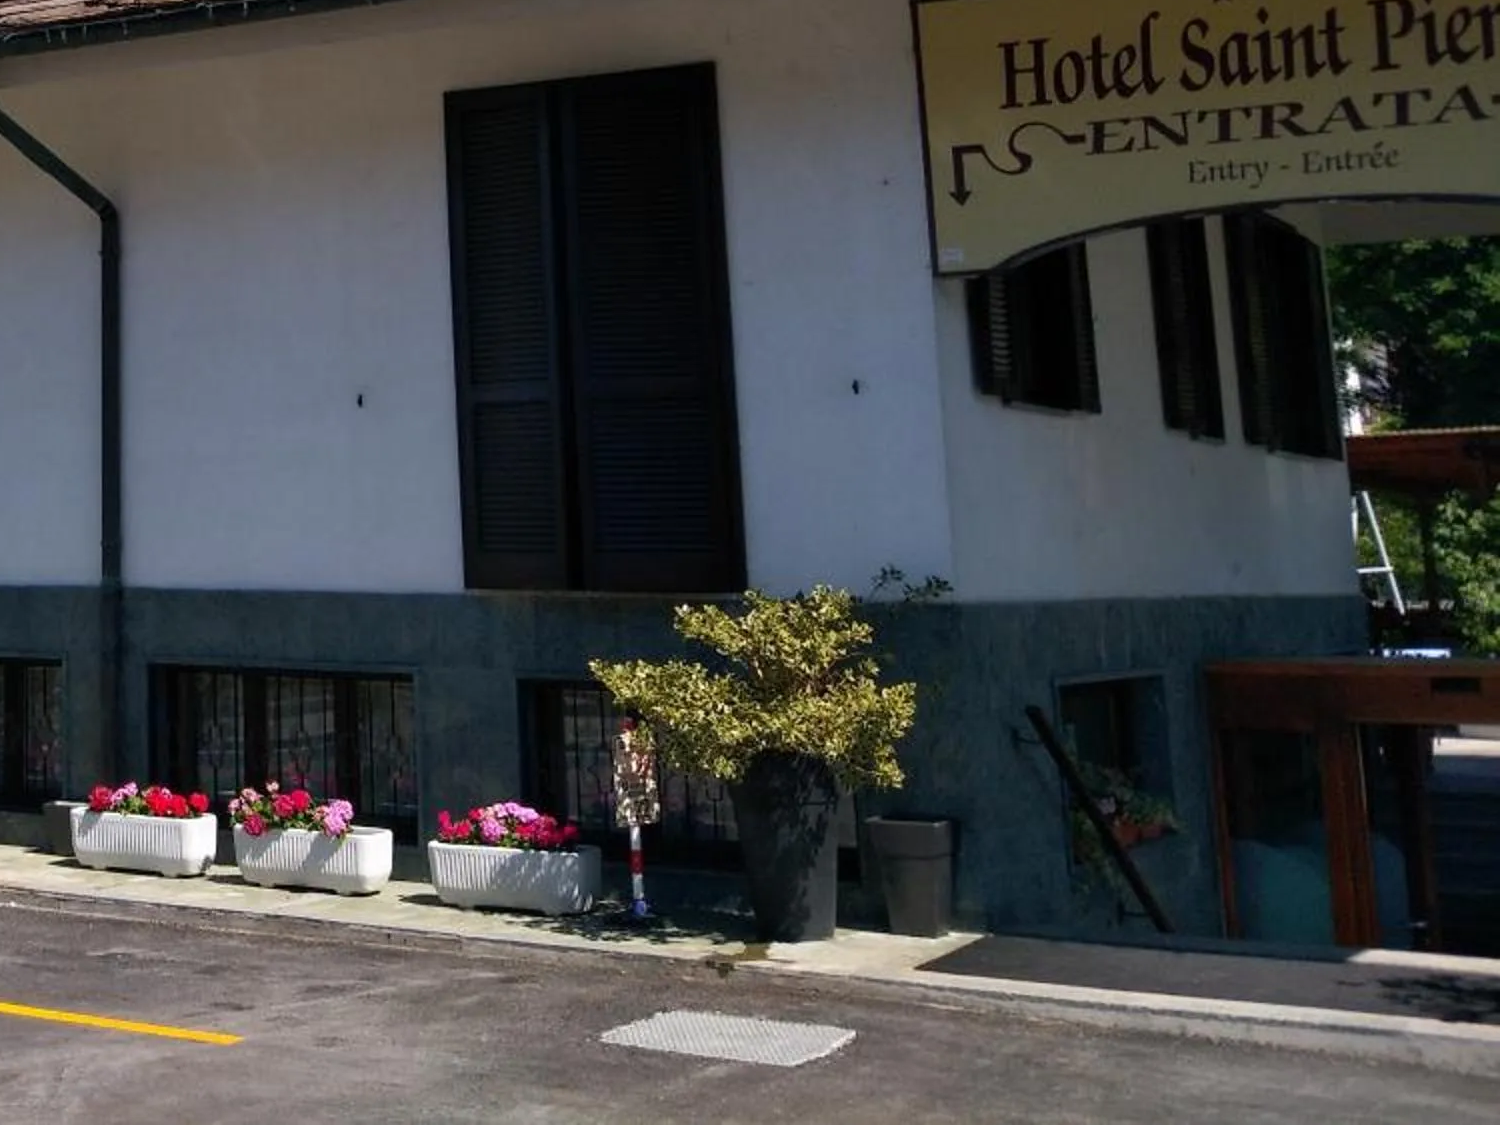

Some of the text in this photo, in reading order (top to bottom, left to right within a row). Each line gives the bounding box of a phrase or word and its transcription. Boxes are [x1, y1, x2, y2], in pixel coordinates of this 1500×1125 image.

[997, 11, 1165, 109] Hotel
[1179, 7, 1353, 92] Saint
[1083, 84, 1493, 156] ENTRATA
[1187, 159, 1270, 190] Entry
[1301, 140, 1400, 175] Entrée
